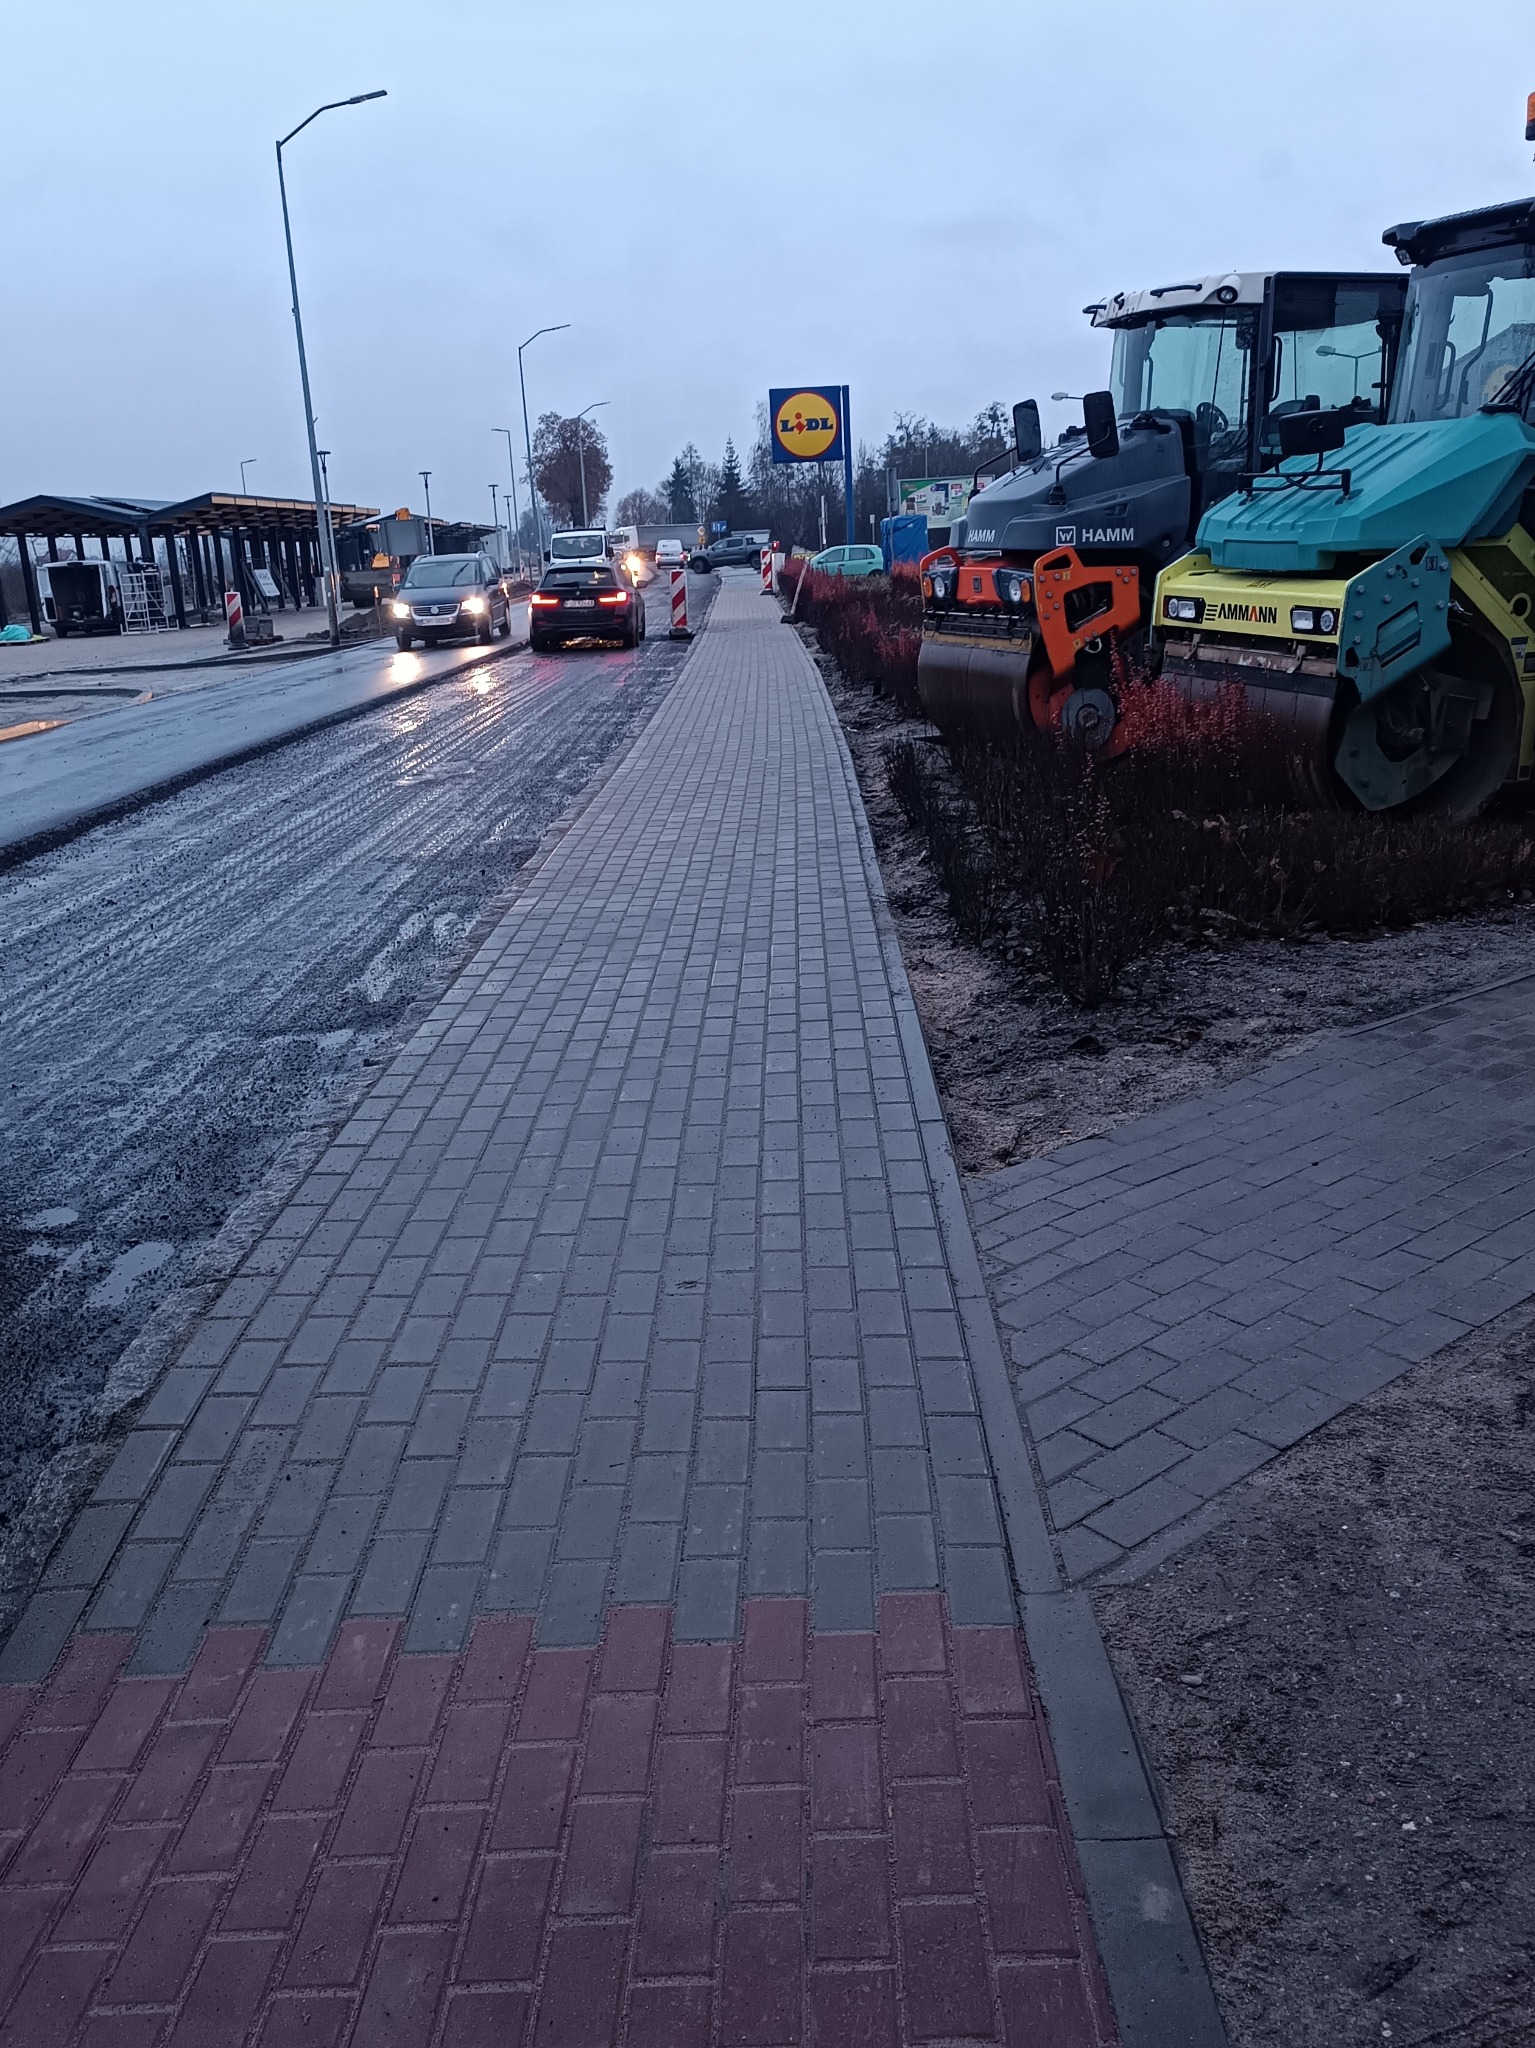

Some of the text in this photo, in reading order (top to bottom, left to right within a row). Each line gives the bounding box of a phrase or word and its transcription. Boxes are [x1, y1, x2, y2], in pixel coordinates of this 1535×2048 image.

[968, 529, 996, 542] HAMM
[1082, 528, 1134, 542] HAMM
[1218, 603, 1277, 624] AMMANN
